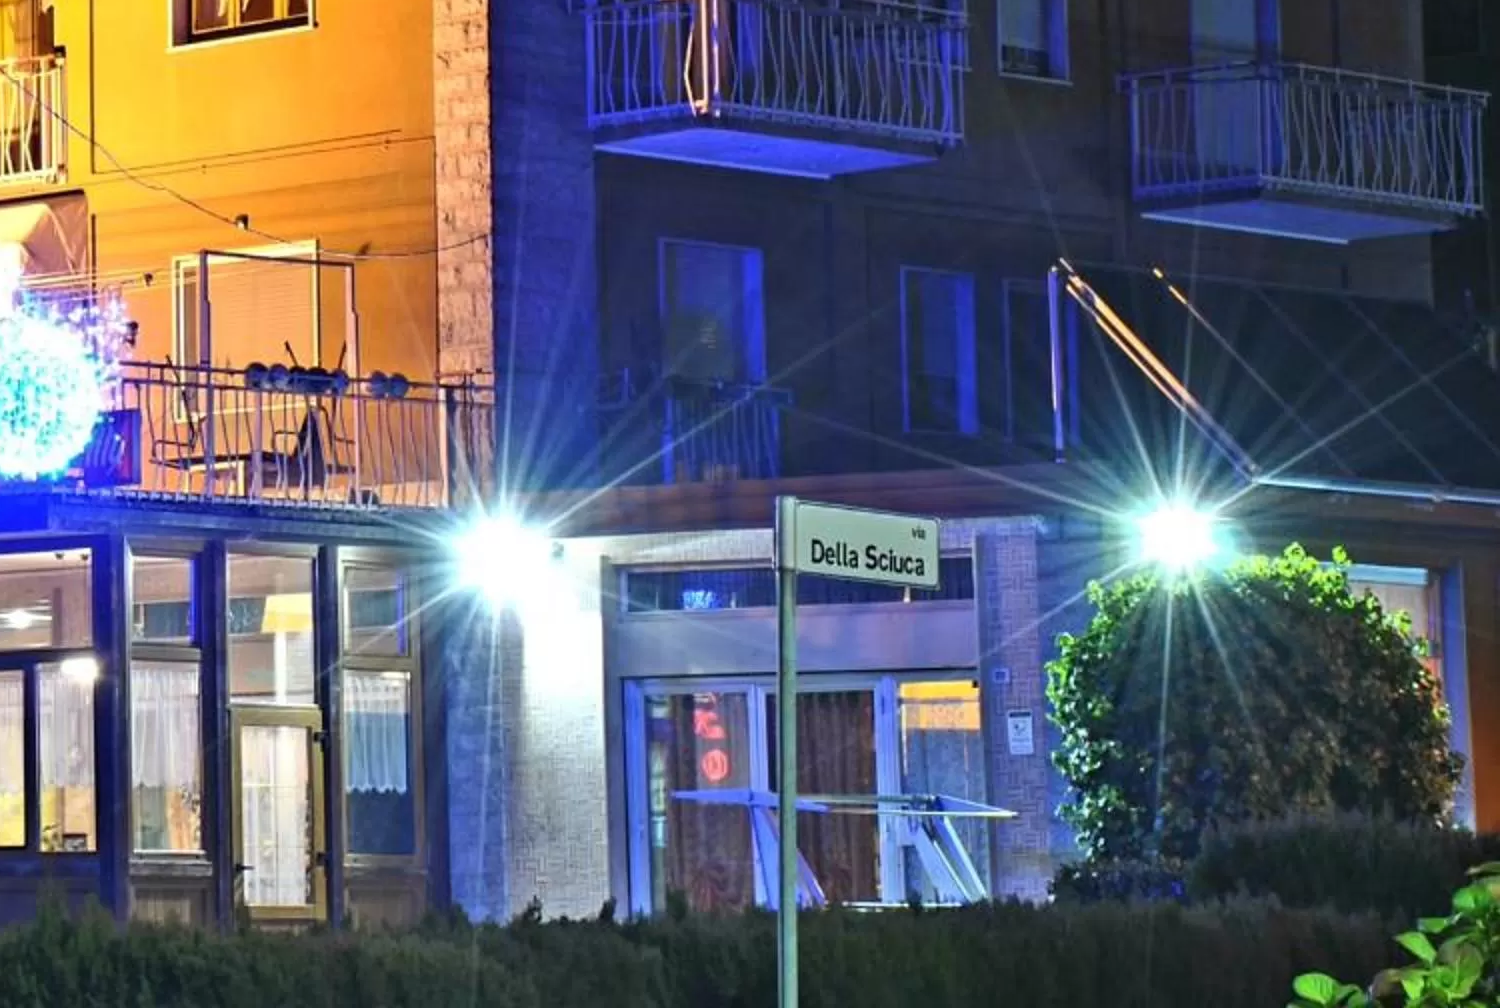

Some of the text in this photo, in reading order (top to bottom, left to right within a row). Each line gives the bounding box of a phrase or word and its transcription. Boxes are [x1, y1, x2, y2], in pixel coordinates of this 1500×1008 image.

[911, 525, 926, 540] via
[811, 539, 925, 576] Della Sciuca
